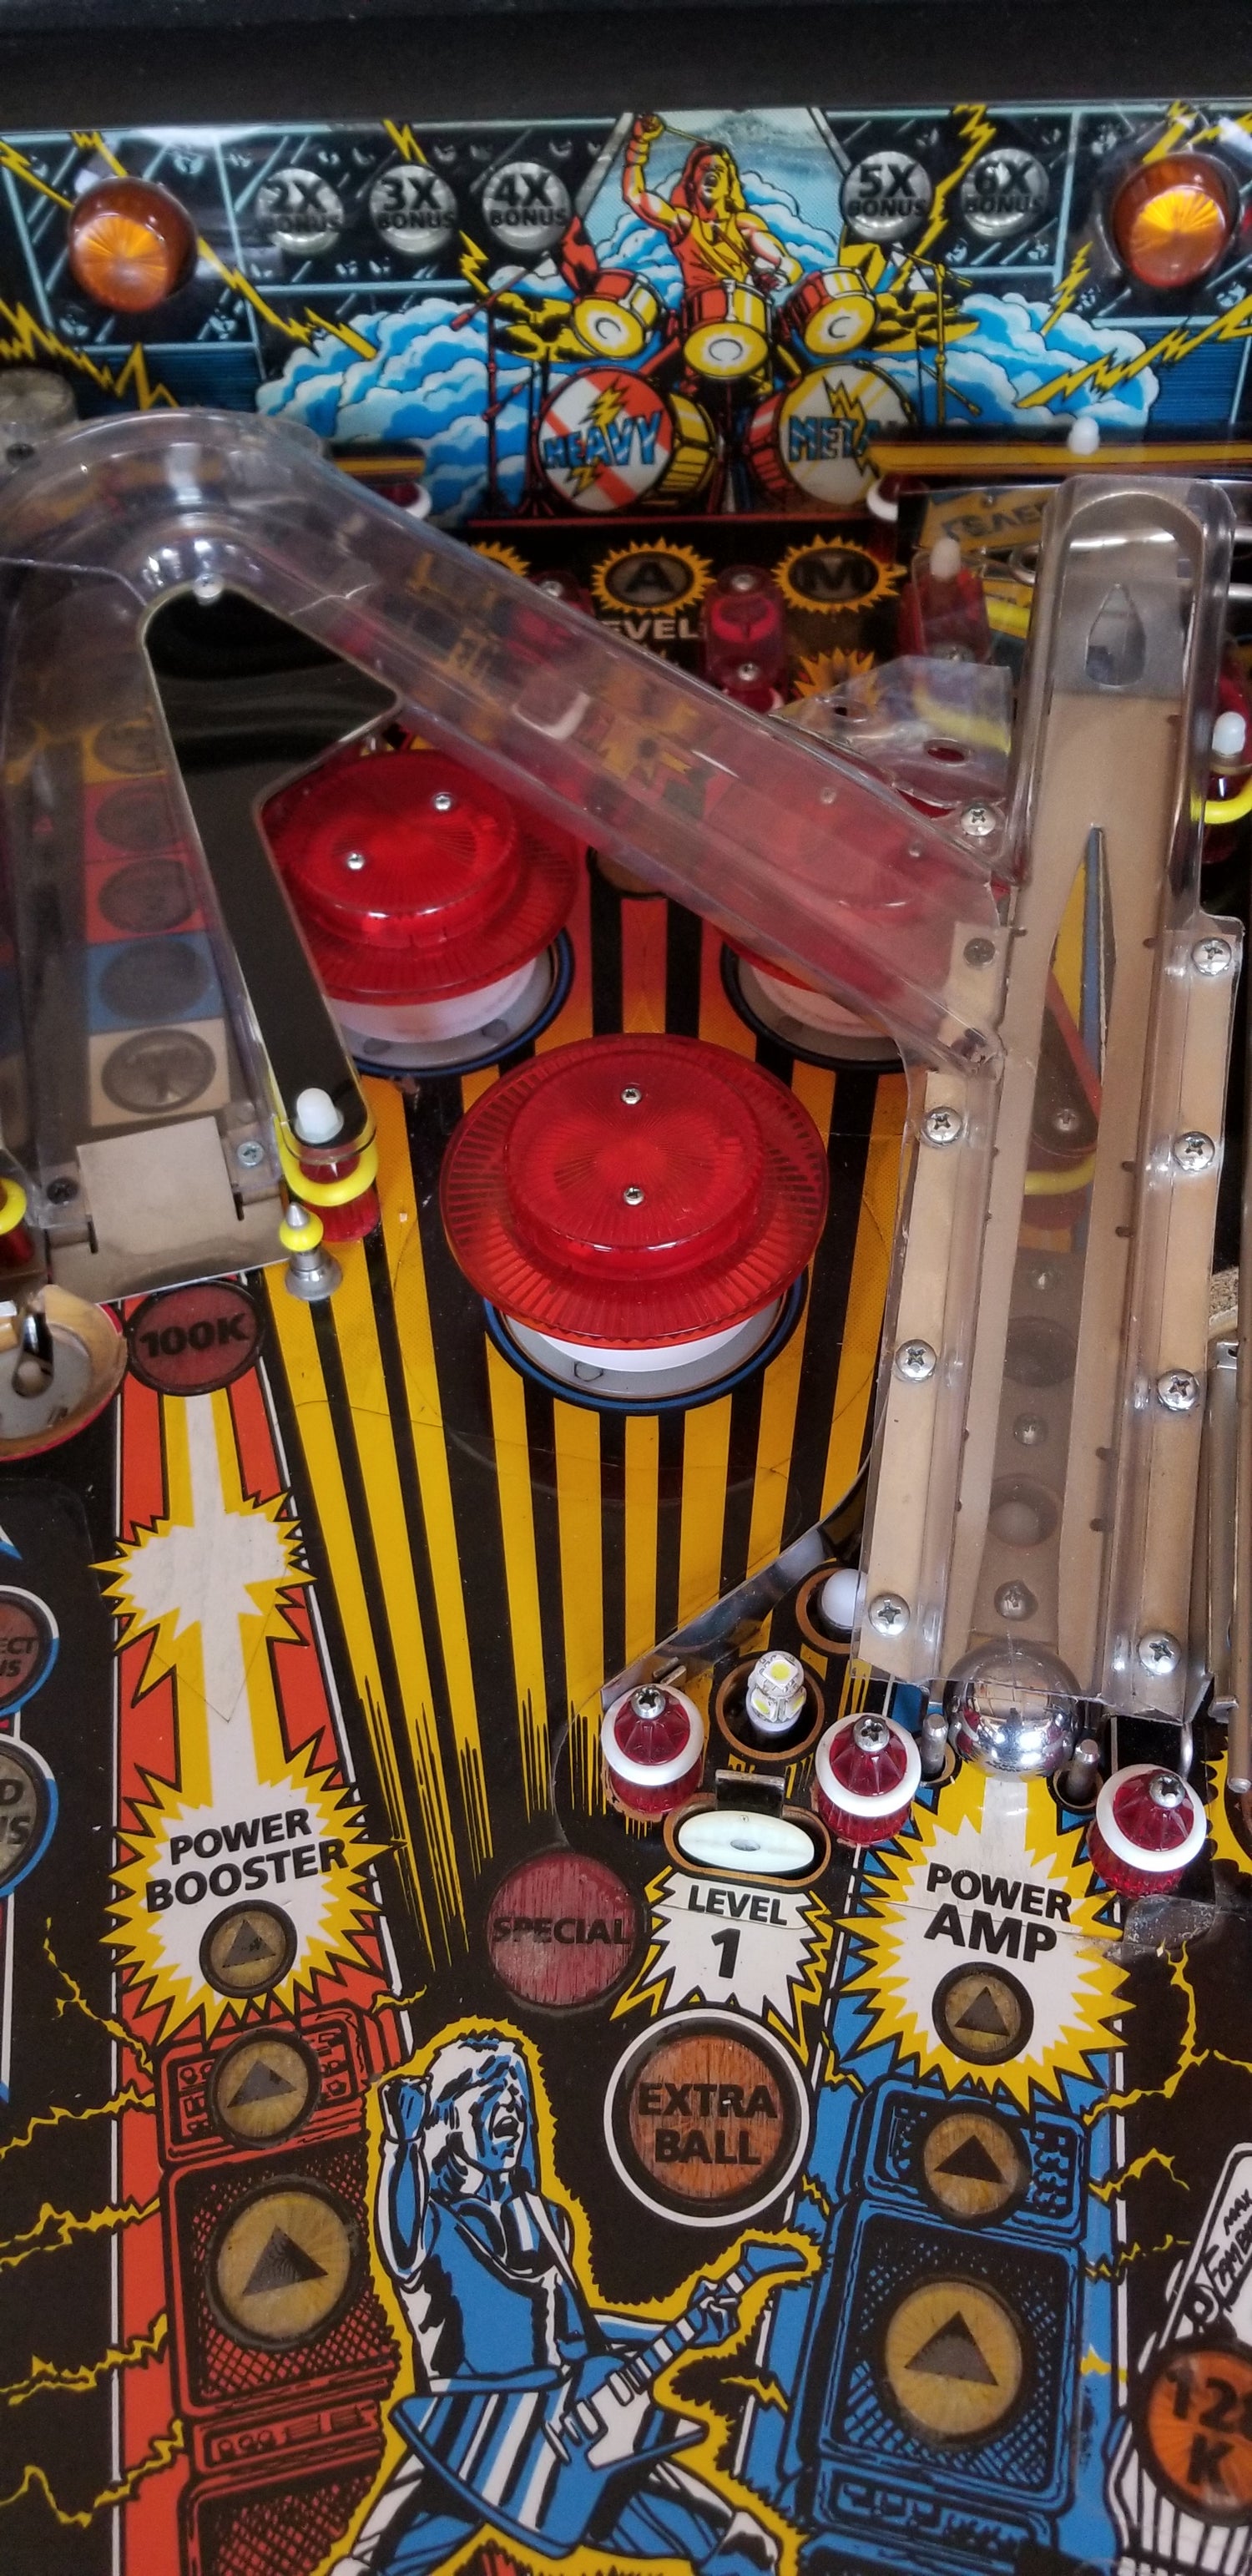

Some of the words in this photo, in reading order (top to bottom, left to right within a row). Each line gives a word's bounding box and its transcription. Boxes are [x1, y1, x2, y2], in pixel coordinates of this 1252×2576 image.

[381, 175, 442, 211] 3X
[493, 172, 553, 207] 4X
[858, 163, 920, 198] 5X
[974, 159, 1035, 195] 6X
[265, 179, 328, 214] 2X
[846, 199, 928, 217] BONUS
[963, 195, 1045, 214] BONUS
[376, 210, 457, 230] BONUS
[490, 208, 568, 227] BONUS
[543, 412, 663, 469] HEAVY
[788, 415, 881, 463] META
[623, 560, 674, 593] A
[794, 558, 876, 593] M
[139, 1313, 250, 1357] 100K
[169, 1807, 313, 1866] POWER
[145, 1837, 350, 1913] BOOSTER
[926, 1861, 1073, 1922] POWER
[688, 1884, 788, 1926] LEVEL
[491, 1917, 631, 1945] SPECIAL
[923, 1902, 1058, 1963] AMP
[710, 1927, 741, 1979] 1
[638, 2082, 779, 2119] EXTRA
[654, 2128, 762, 2165] BALL
[1186, 2432, 1235, 2495] K
